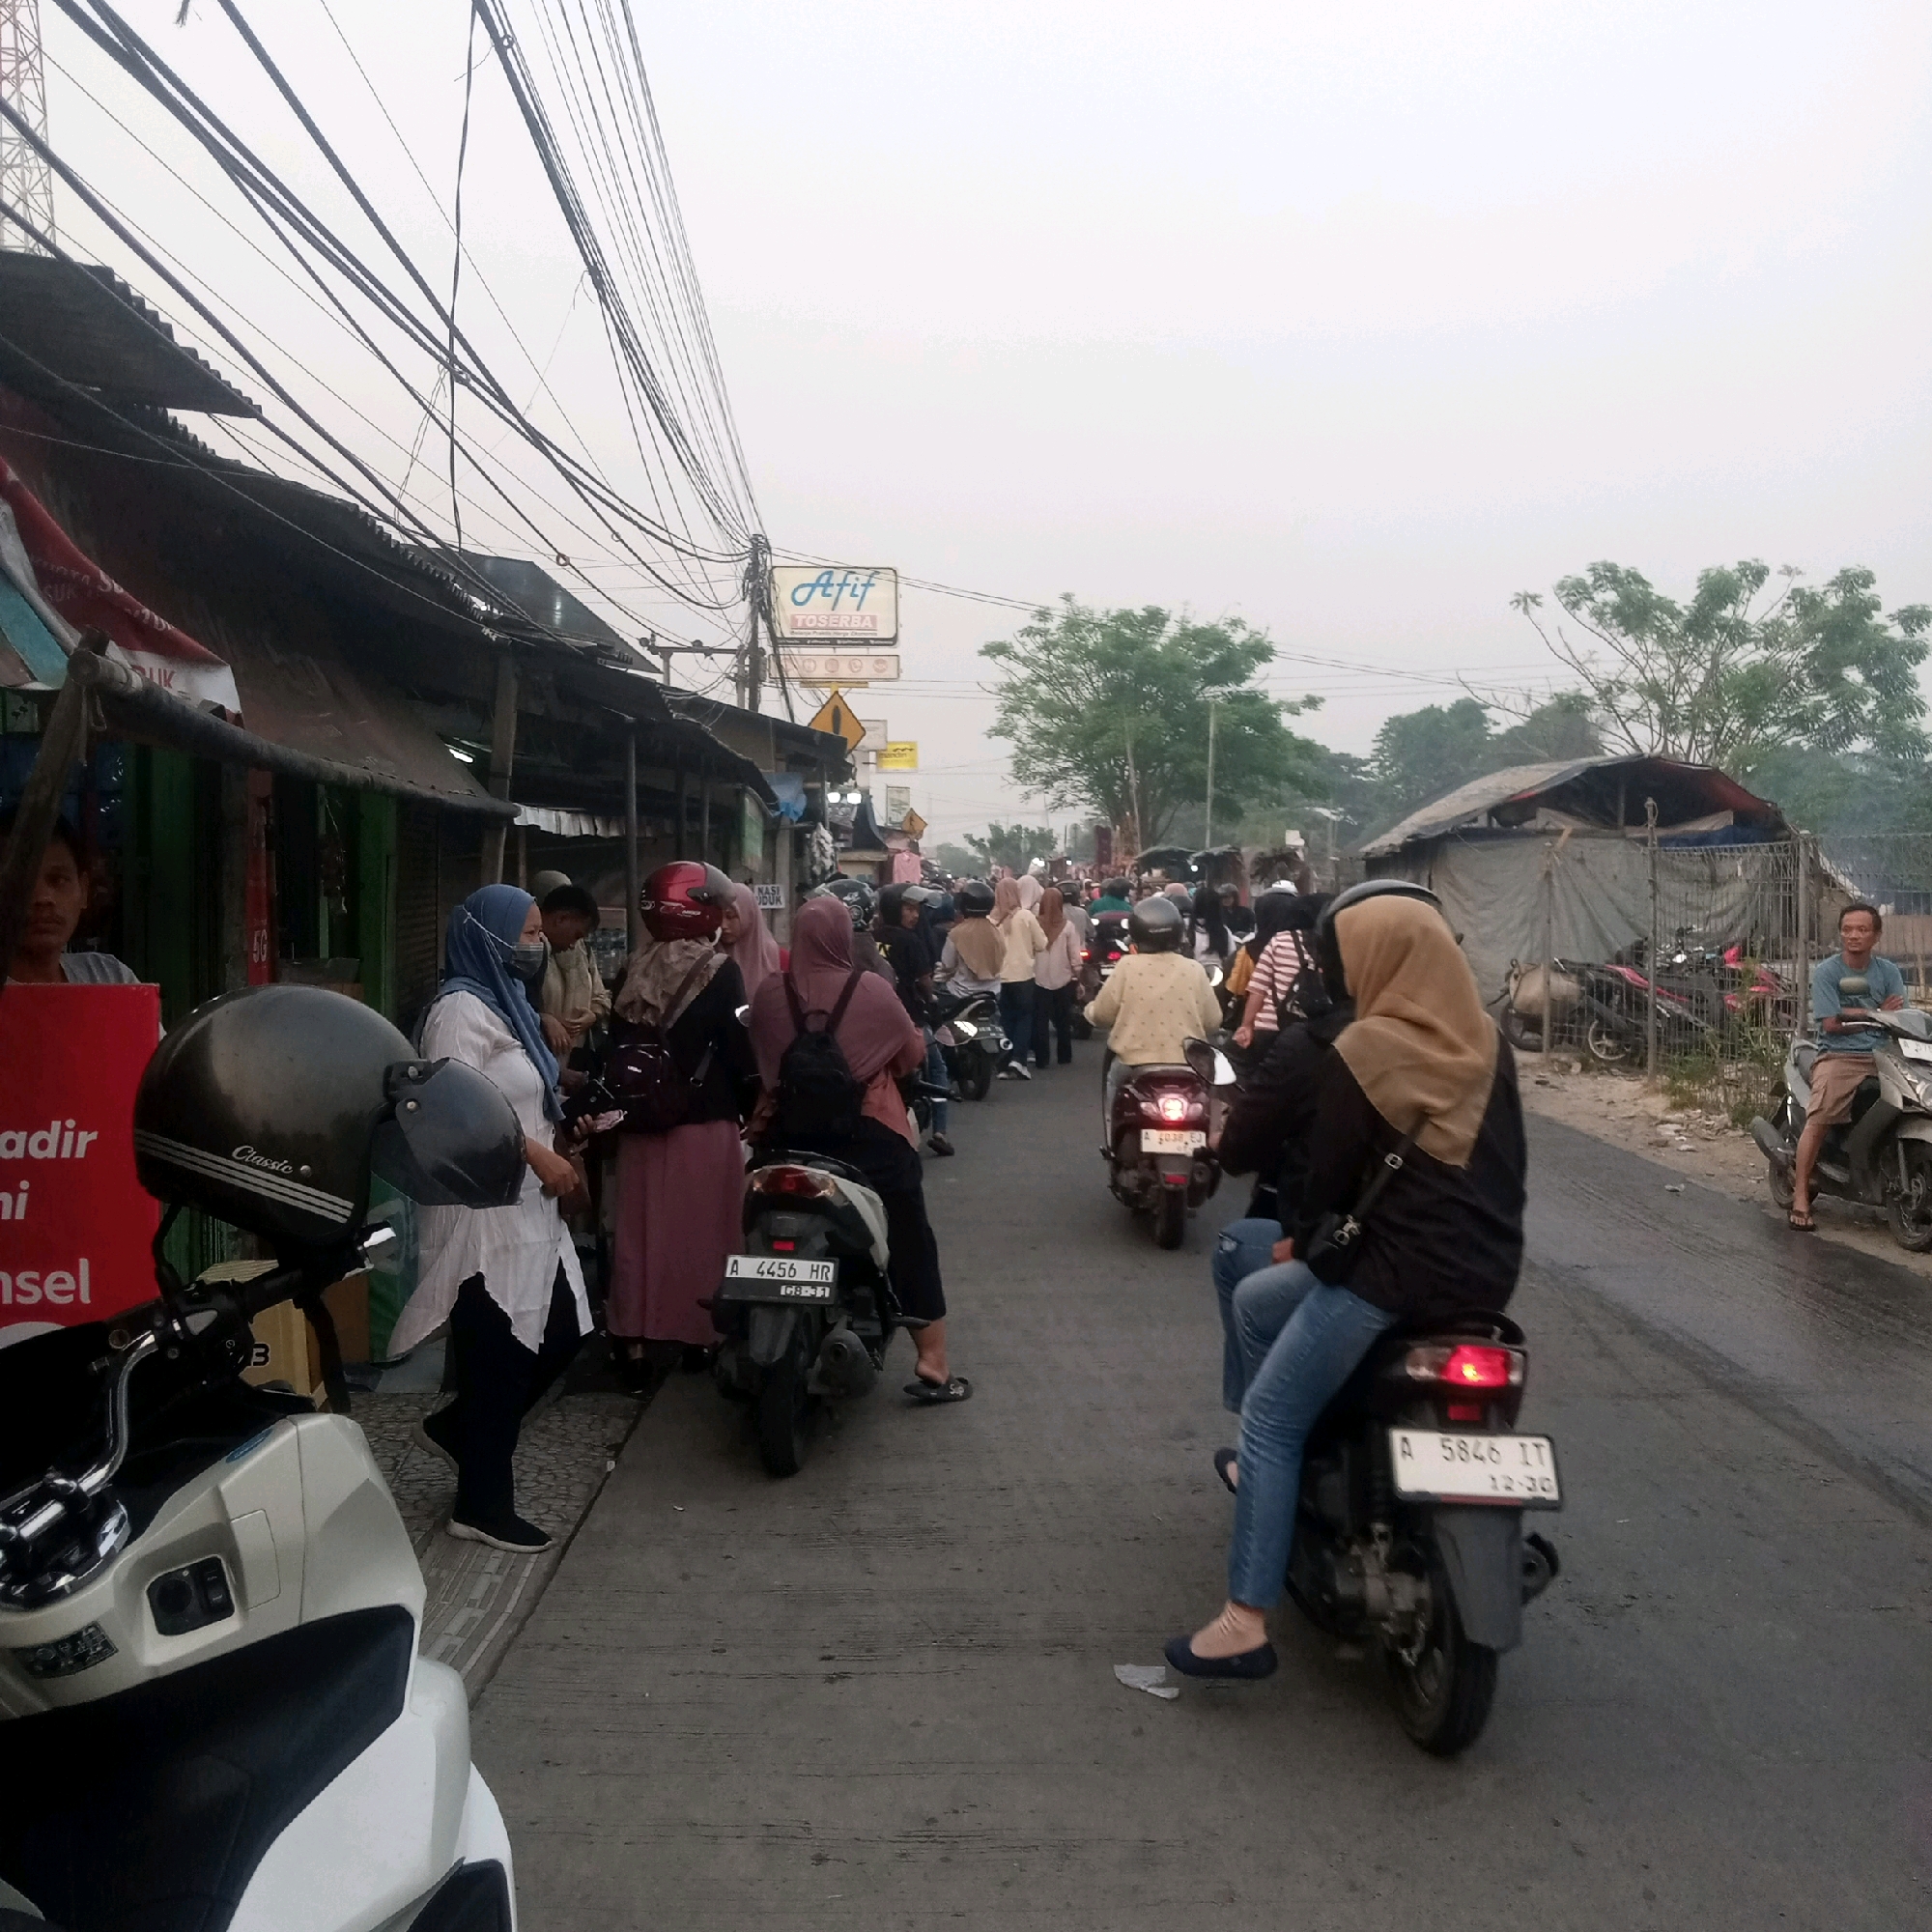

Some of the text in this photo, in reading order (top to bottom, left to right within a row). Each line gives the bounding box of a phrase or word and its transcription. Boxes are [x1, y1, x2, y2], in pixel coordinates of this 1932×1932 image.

[790, 570, 879, 611] Afif
[794, 614, 873, 628] TOSERBA
[757, 886, 781, 896] NASI
[252, 928, 269, 963] 5G
[0, 1118, 99, 1159] adir
[1144, 1132, 1151, 1141] A
[231, 1145, 294, 1175] Classic
[729, 1259, 831, 1281] A 4456 HR
[1400, 1436, 1546, 1467] A 5846 IT
